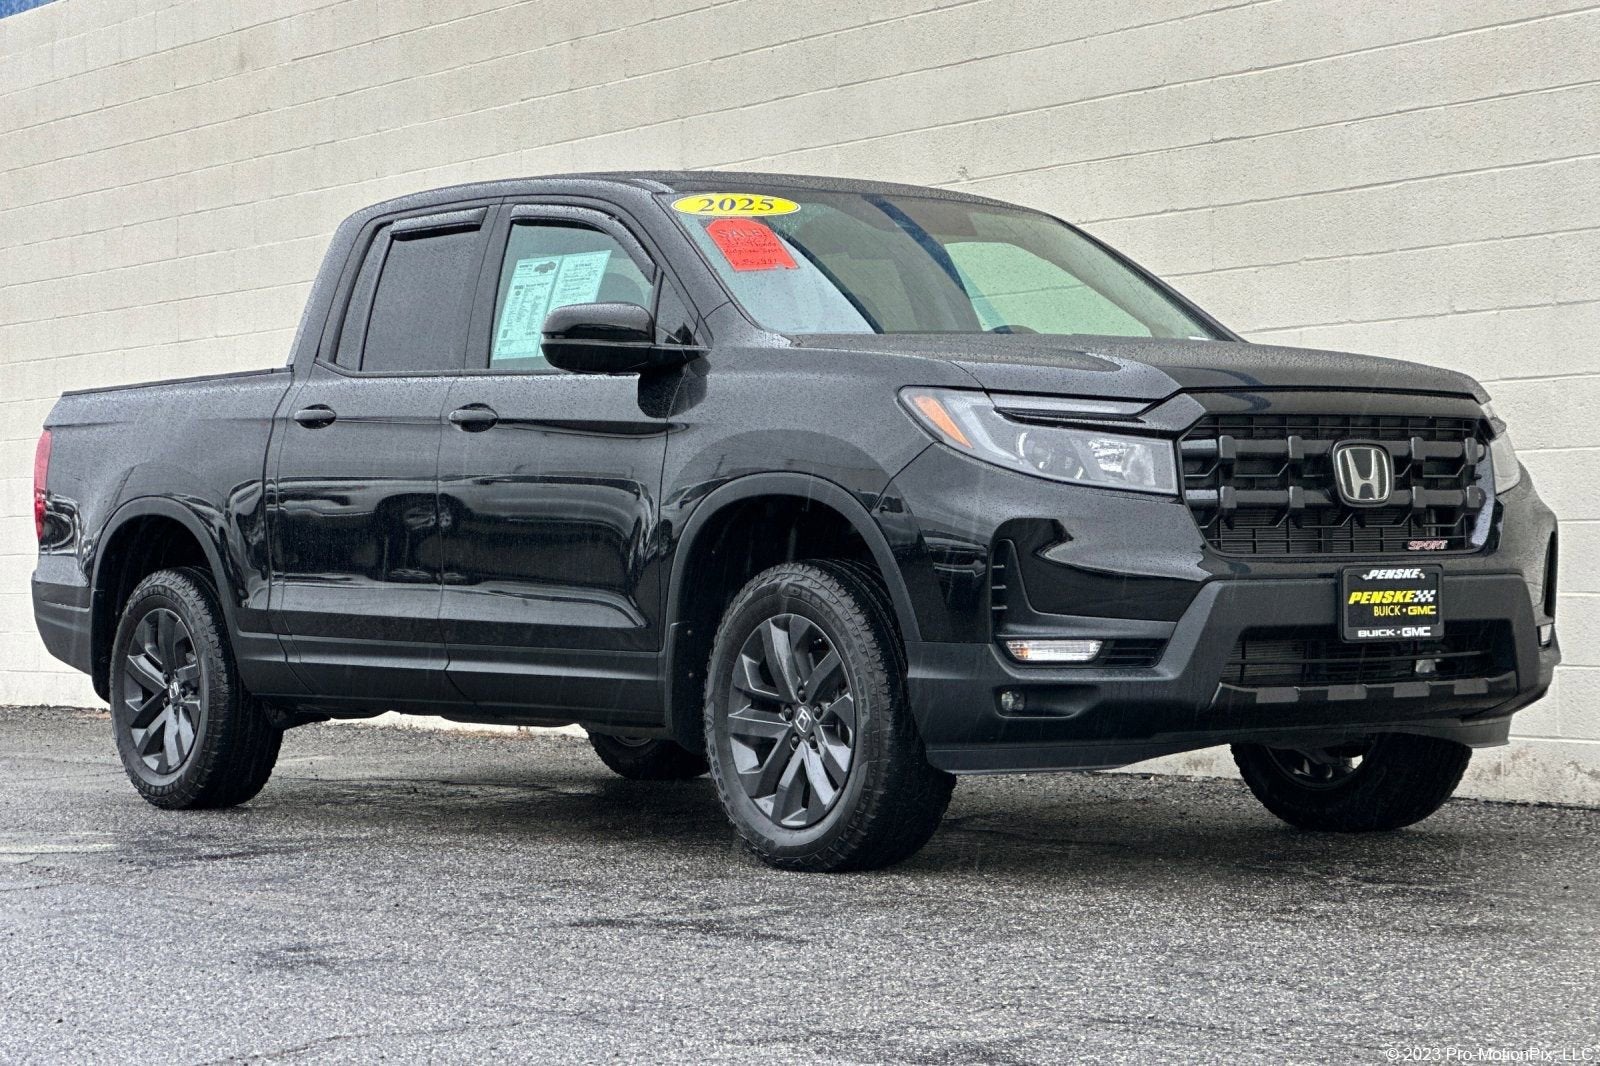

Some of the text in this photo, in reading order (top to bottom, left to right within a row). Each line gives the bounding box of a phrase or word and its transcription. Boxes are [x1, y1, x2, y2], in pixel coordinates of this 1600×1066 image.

[698, 198, 775, 212] 2025
[1408, 540, 1448, 550] SPORT
[1367, 568, 1421, 580] PENSKE
[1348, 590, 1416, 604] PENSKE
[1373, 605, 1436, 616] BUICK GMC
[1358, 627, 1431, 637] BUICK GMC
